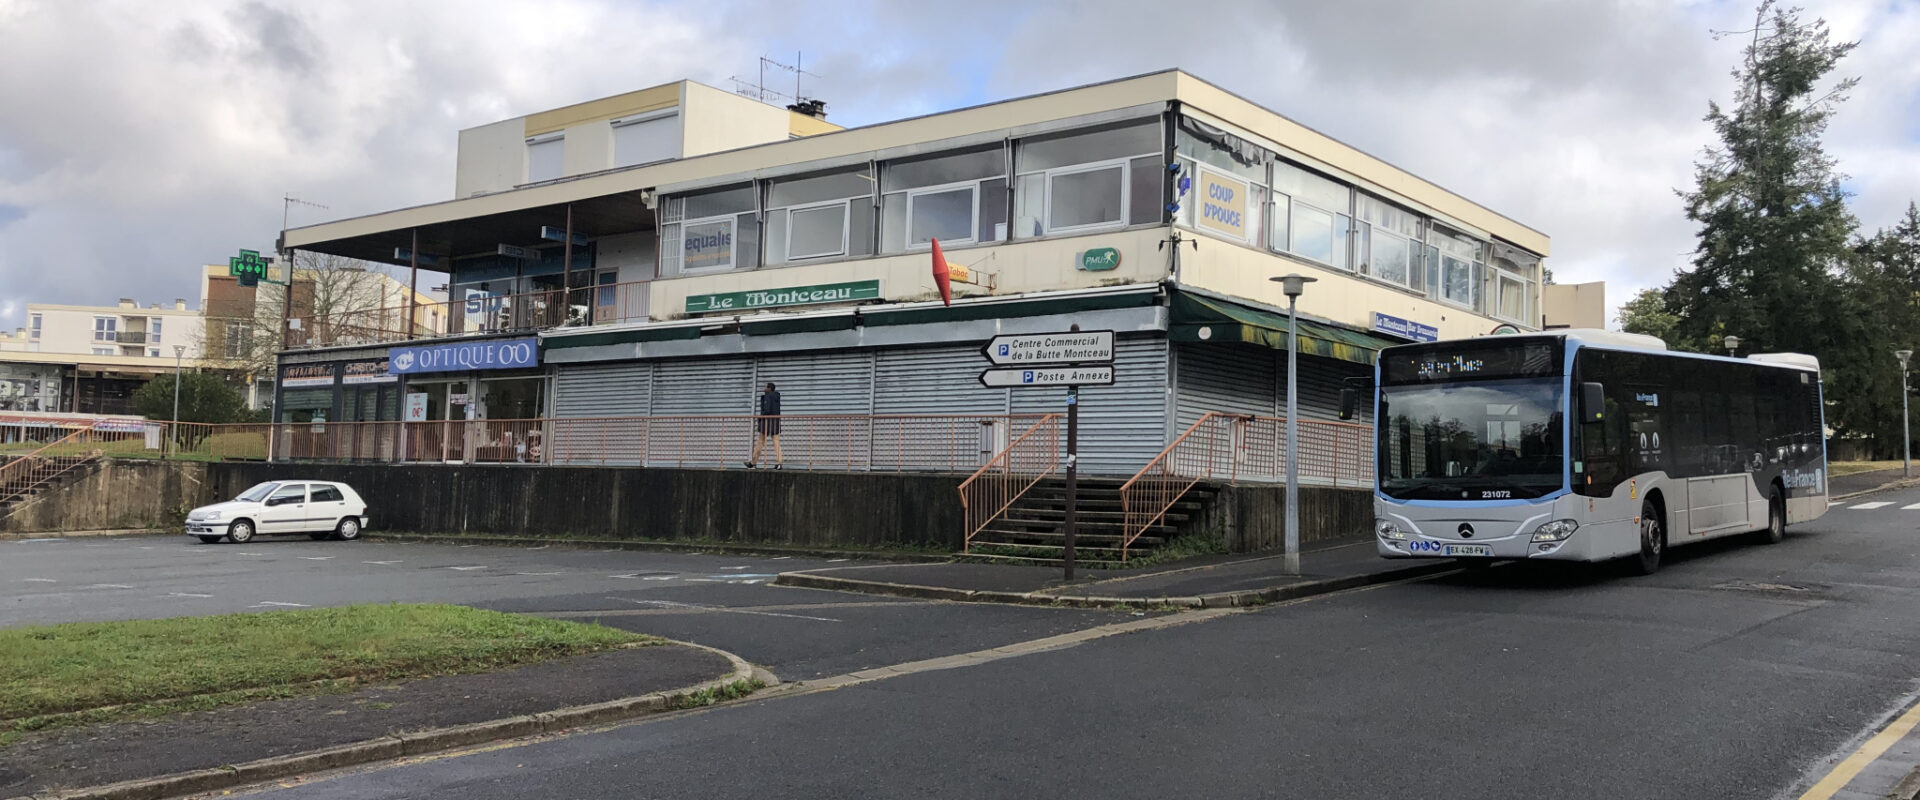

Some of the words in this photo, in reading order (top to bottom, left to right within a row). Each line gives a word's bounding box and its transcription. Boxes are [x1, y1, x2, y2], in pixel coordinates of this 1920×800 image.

[1209, 182, 1234, 204] COUP
[1204, 202, 1241, 227] D'POUCE
[685, 231, 731, 252] equalis
[1085, 255, 1104, 265] PMU
[949, 265, 968, 278] Tabac
[708, 295, 733, 309] Le
[745, 287, 852, 306] Montceau
[1012, 339, 1041, 348] Centre
[1044, 335, 1099, 347] Commercial
[419, 345, 494, 369] OPTIQUE
[1011, 350, 1022, 360] de
[1025, 350, 1033, 359] la
[1036, 350, 1060, 359] Butte
[1063, 348, 1109, 358] Montceau
[1036, 372, 1065, 381] Poste
[1071, 370, 1110, 380] Annexe
[1482, 490, 1511, 498] 231072
